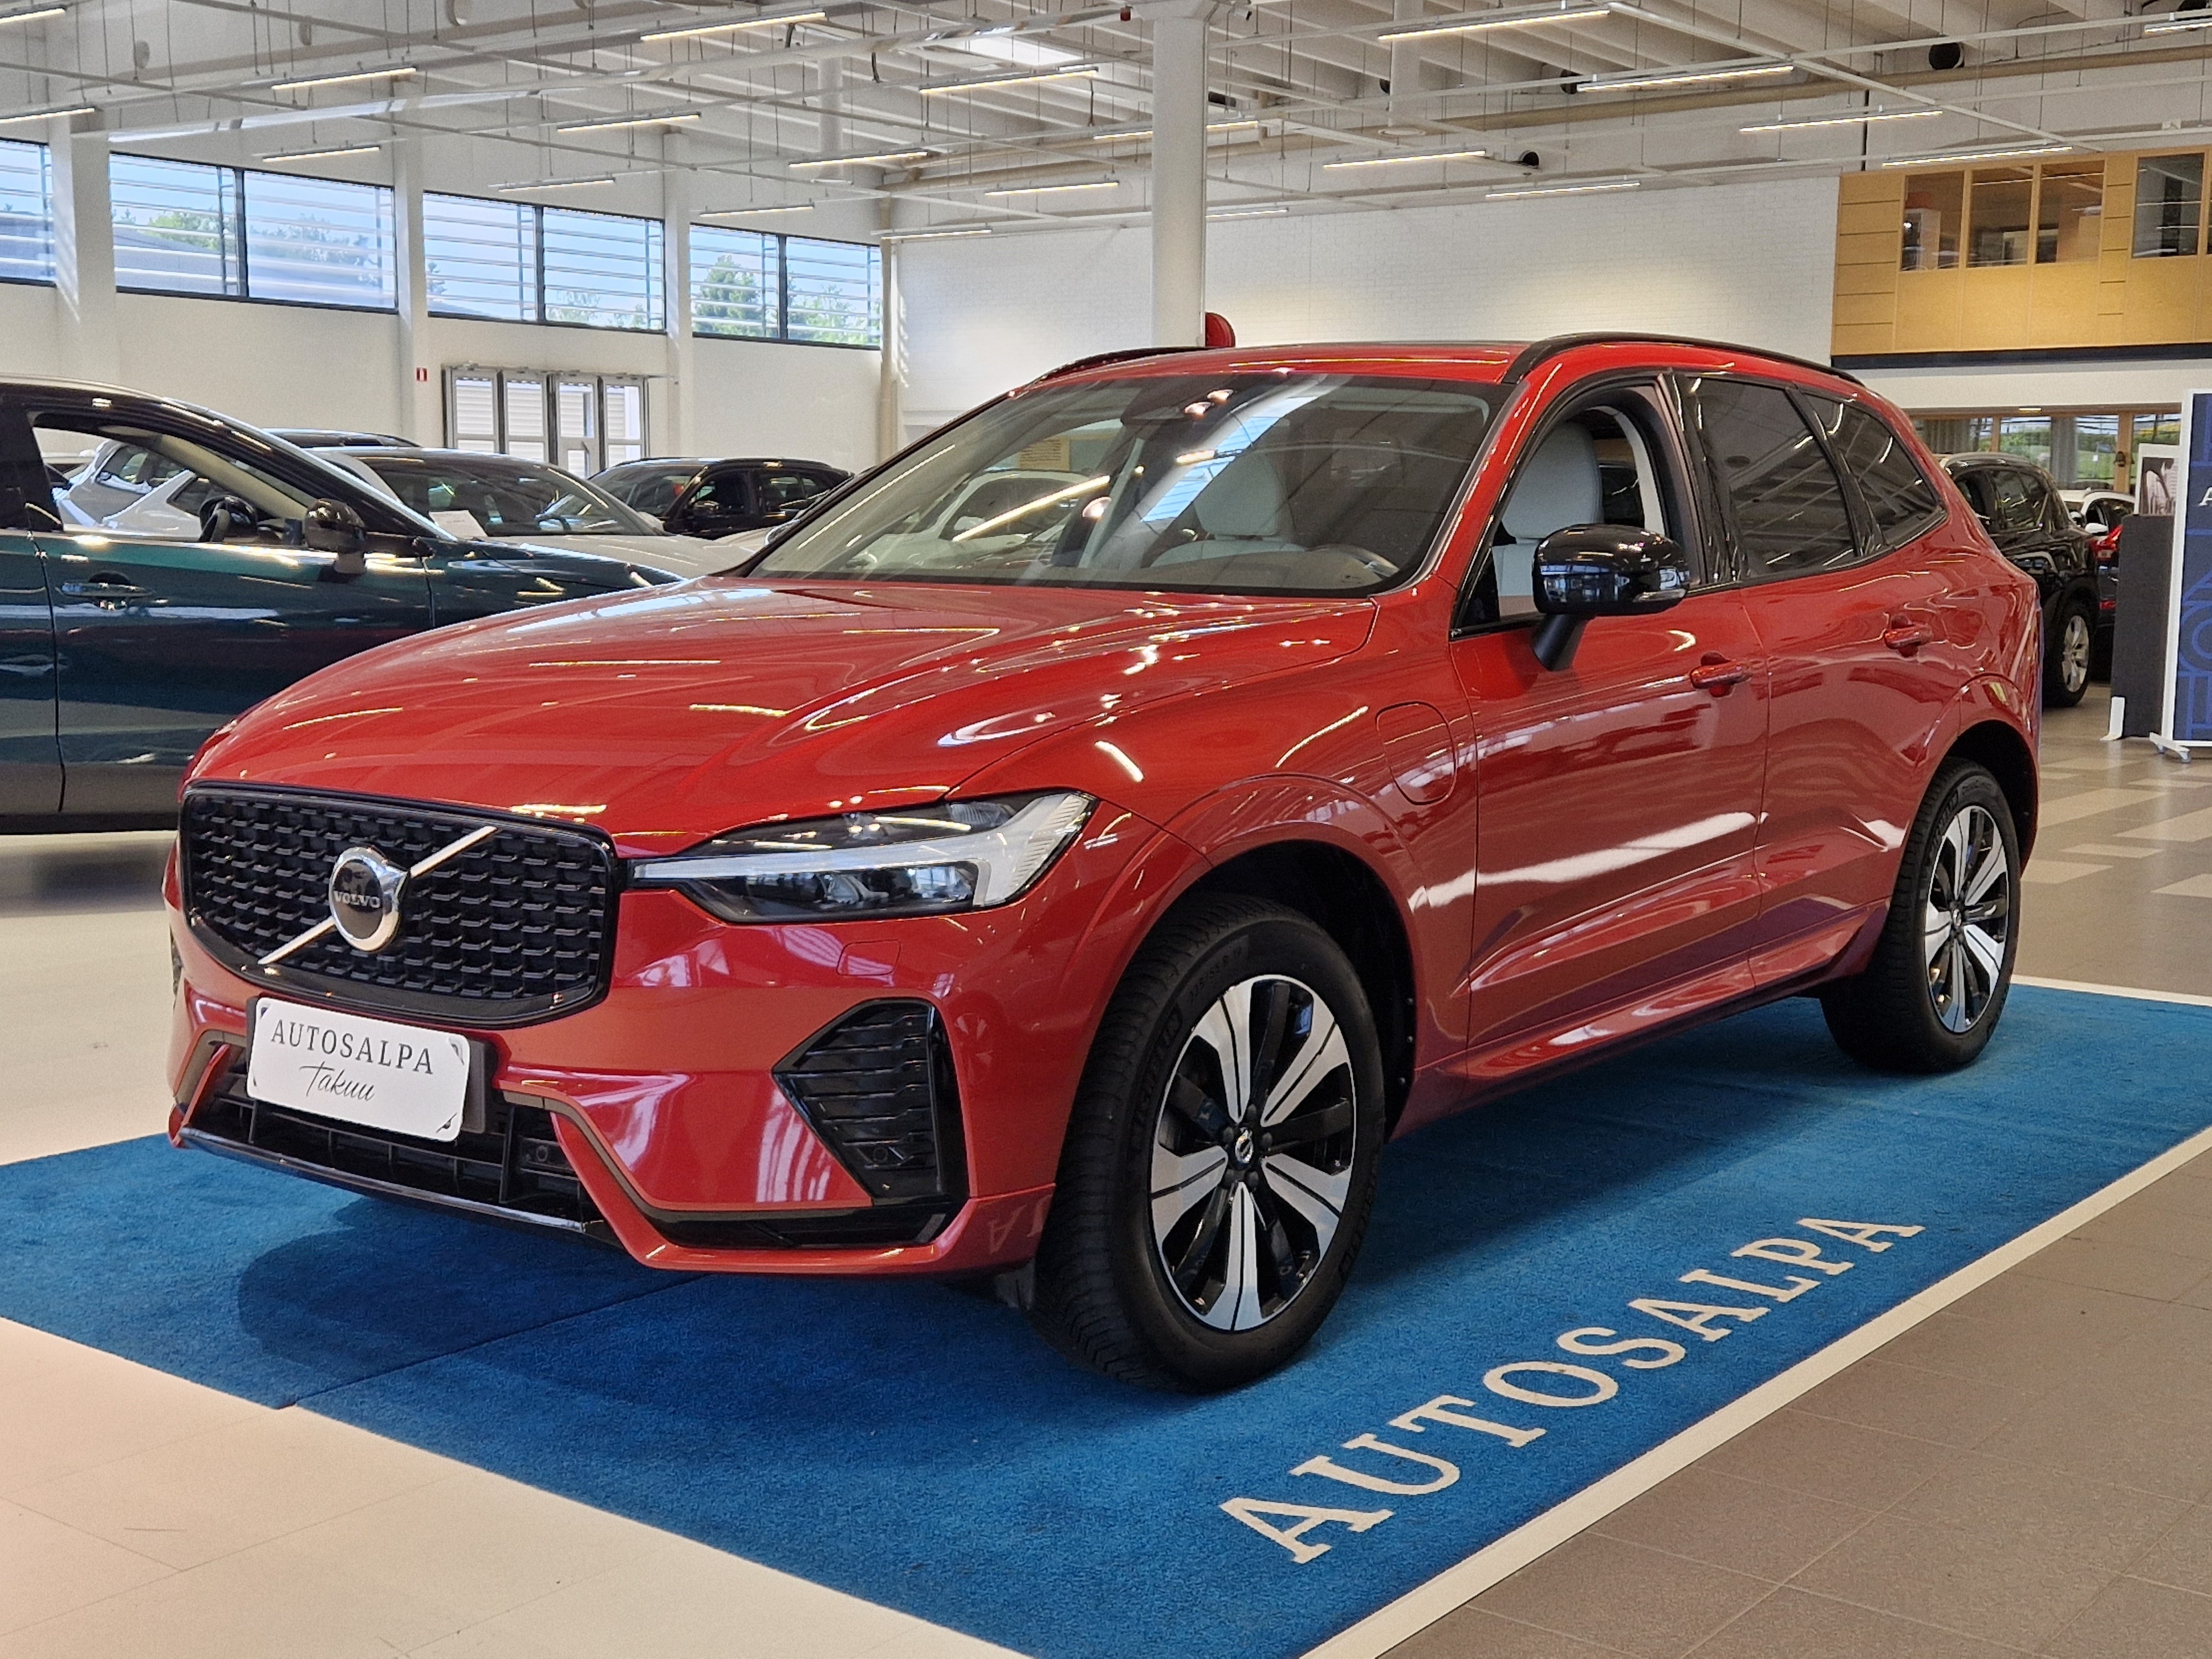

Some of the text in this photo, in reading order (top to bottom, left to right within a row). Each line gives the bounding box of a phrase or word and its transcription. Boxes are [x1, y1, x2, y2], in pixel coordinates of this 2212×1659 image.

[333, 890, 380, 908] VOLVO
[271, 1019, 433, 1074] AUTOSALPA
[299, 1061, 375, 1101] Takuu
[1220, 1217, 1926, 1564] AUTOSALPA
